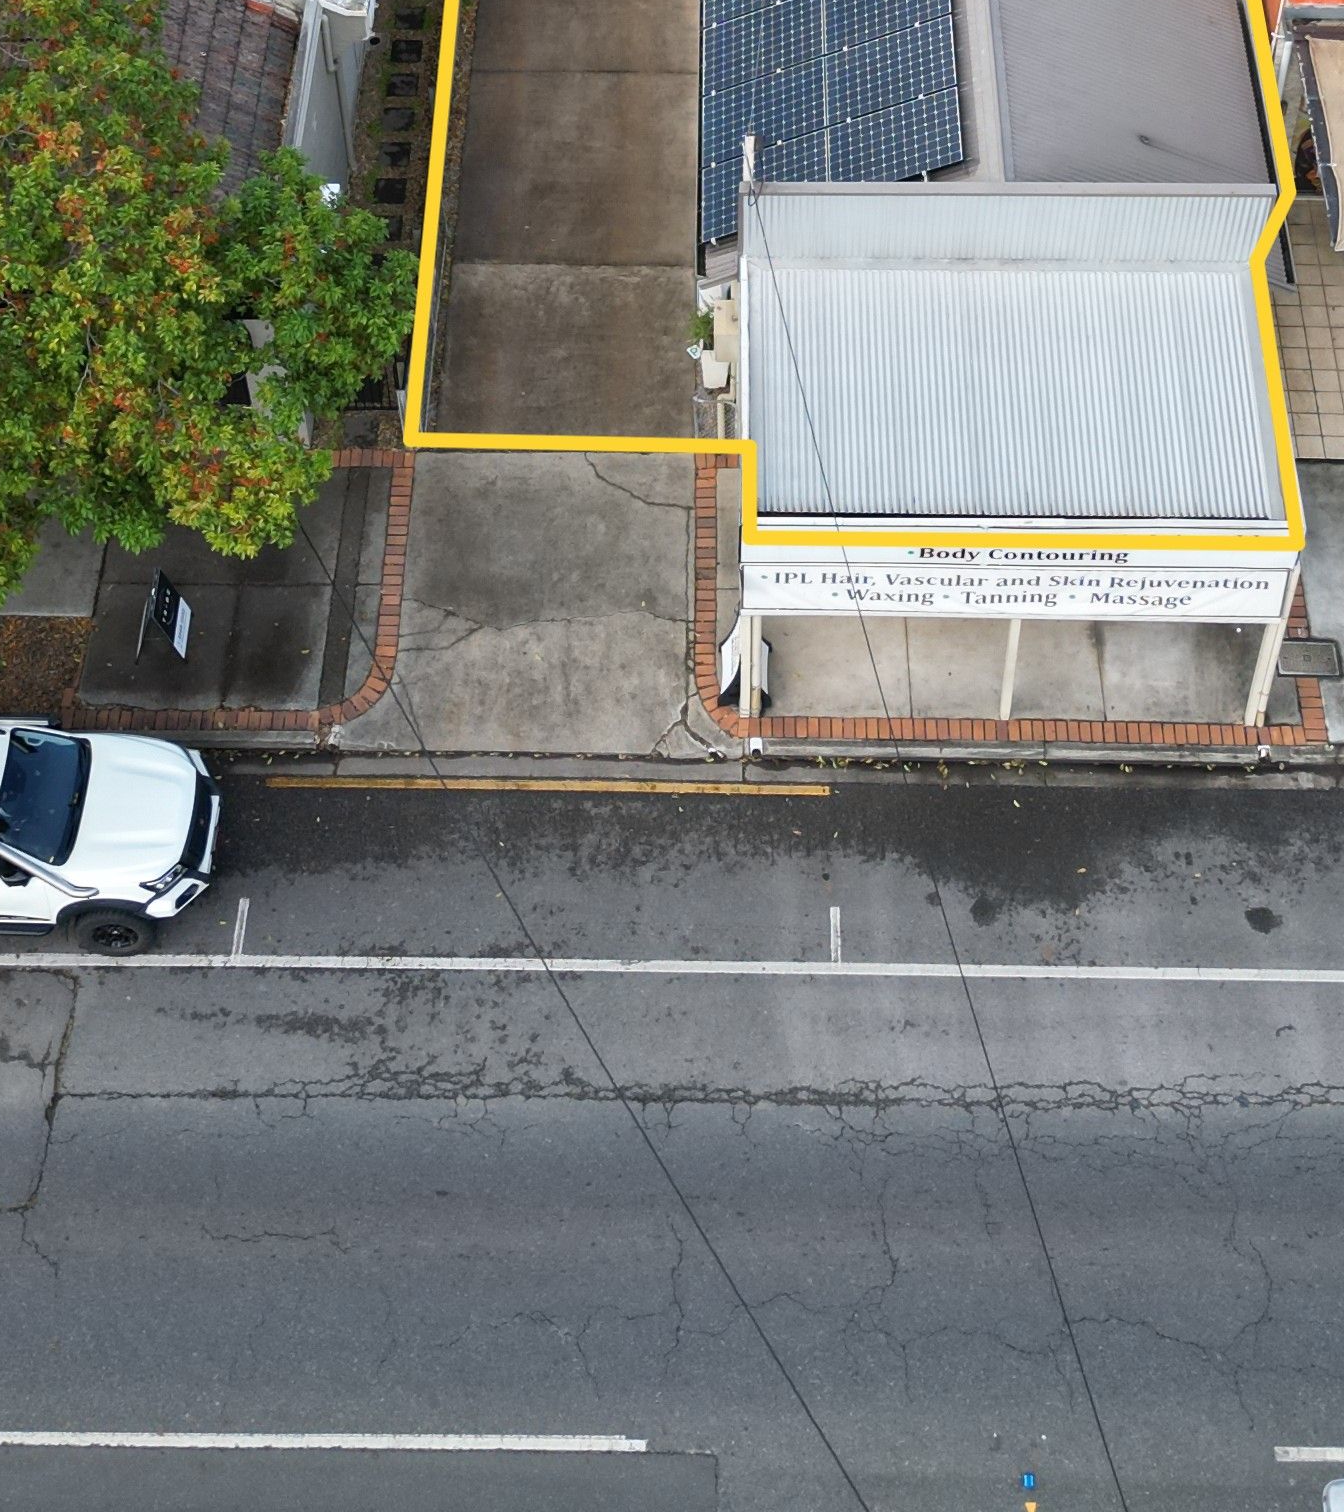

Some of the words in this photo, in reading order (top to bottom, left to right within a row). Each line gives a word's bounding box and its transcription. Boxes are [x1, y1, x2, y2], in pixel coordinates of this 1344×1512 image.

[920, 548, 980, 564] Body
[988, 548, 1130, 564] Contouring
[774, 572, 813, 584] IPL
[886, 573, 989, 587] Vascular
[996, 574, 1041, 588] and
[1048, 575, 1101, 588] Skin
[1109, 576, 1270, 591] Rejuvenation
[846, 588, 935, 606] Waxing
[961, 590, 1057, 608] Tanning
[1090, 592, 1192, 609] Massage
